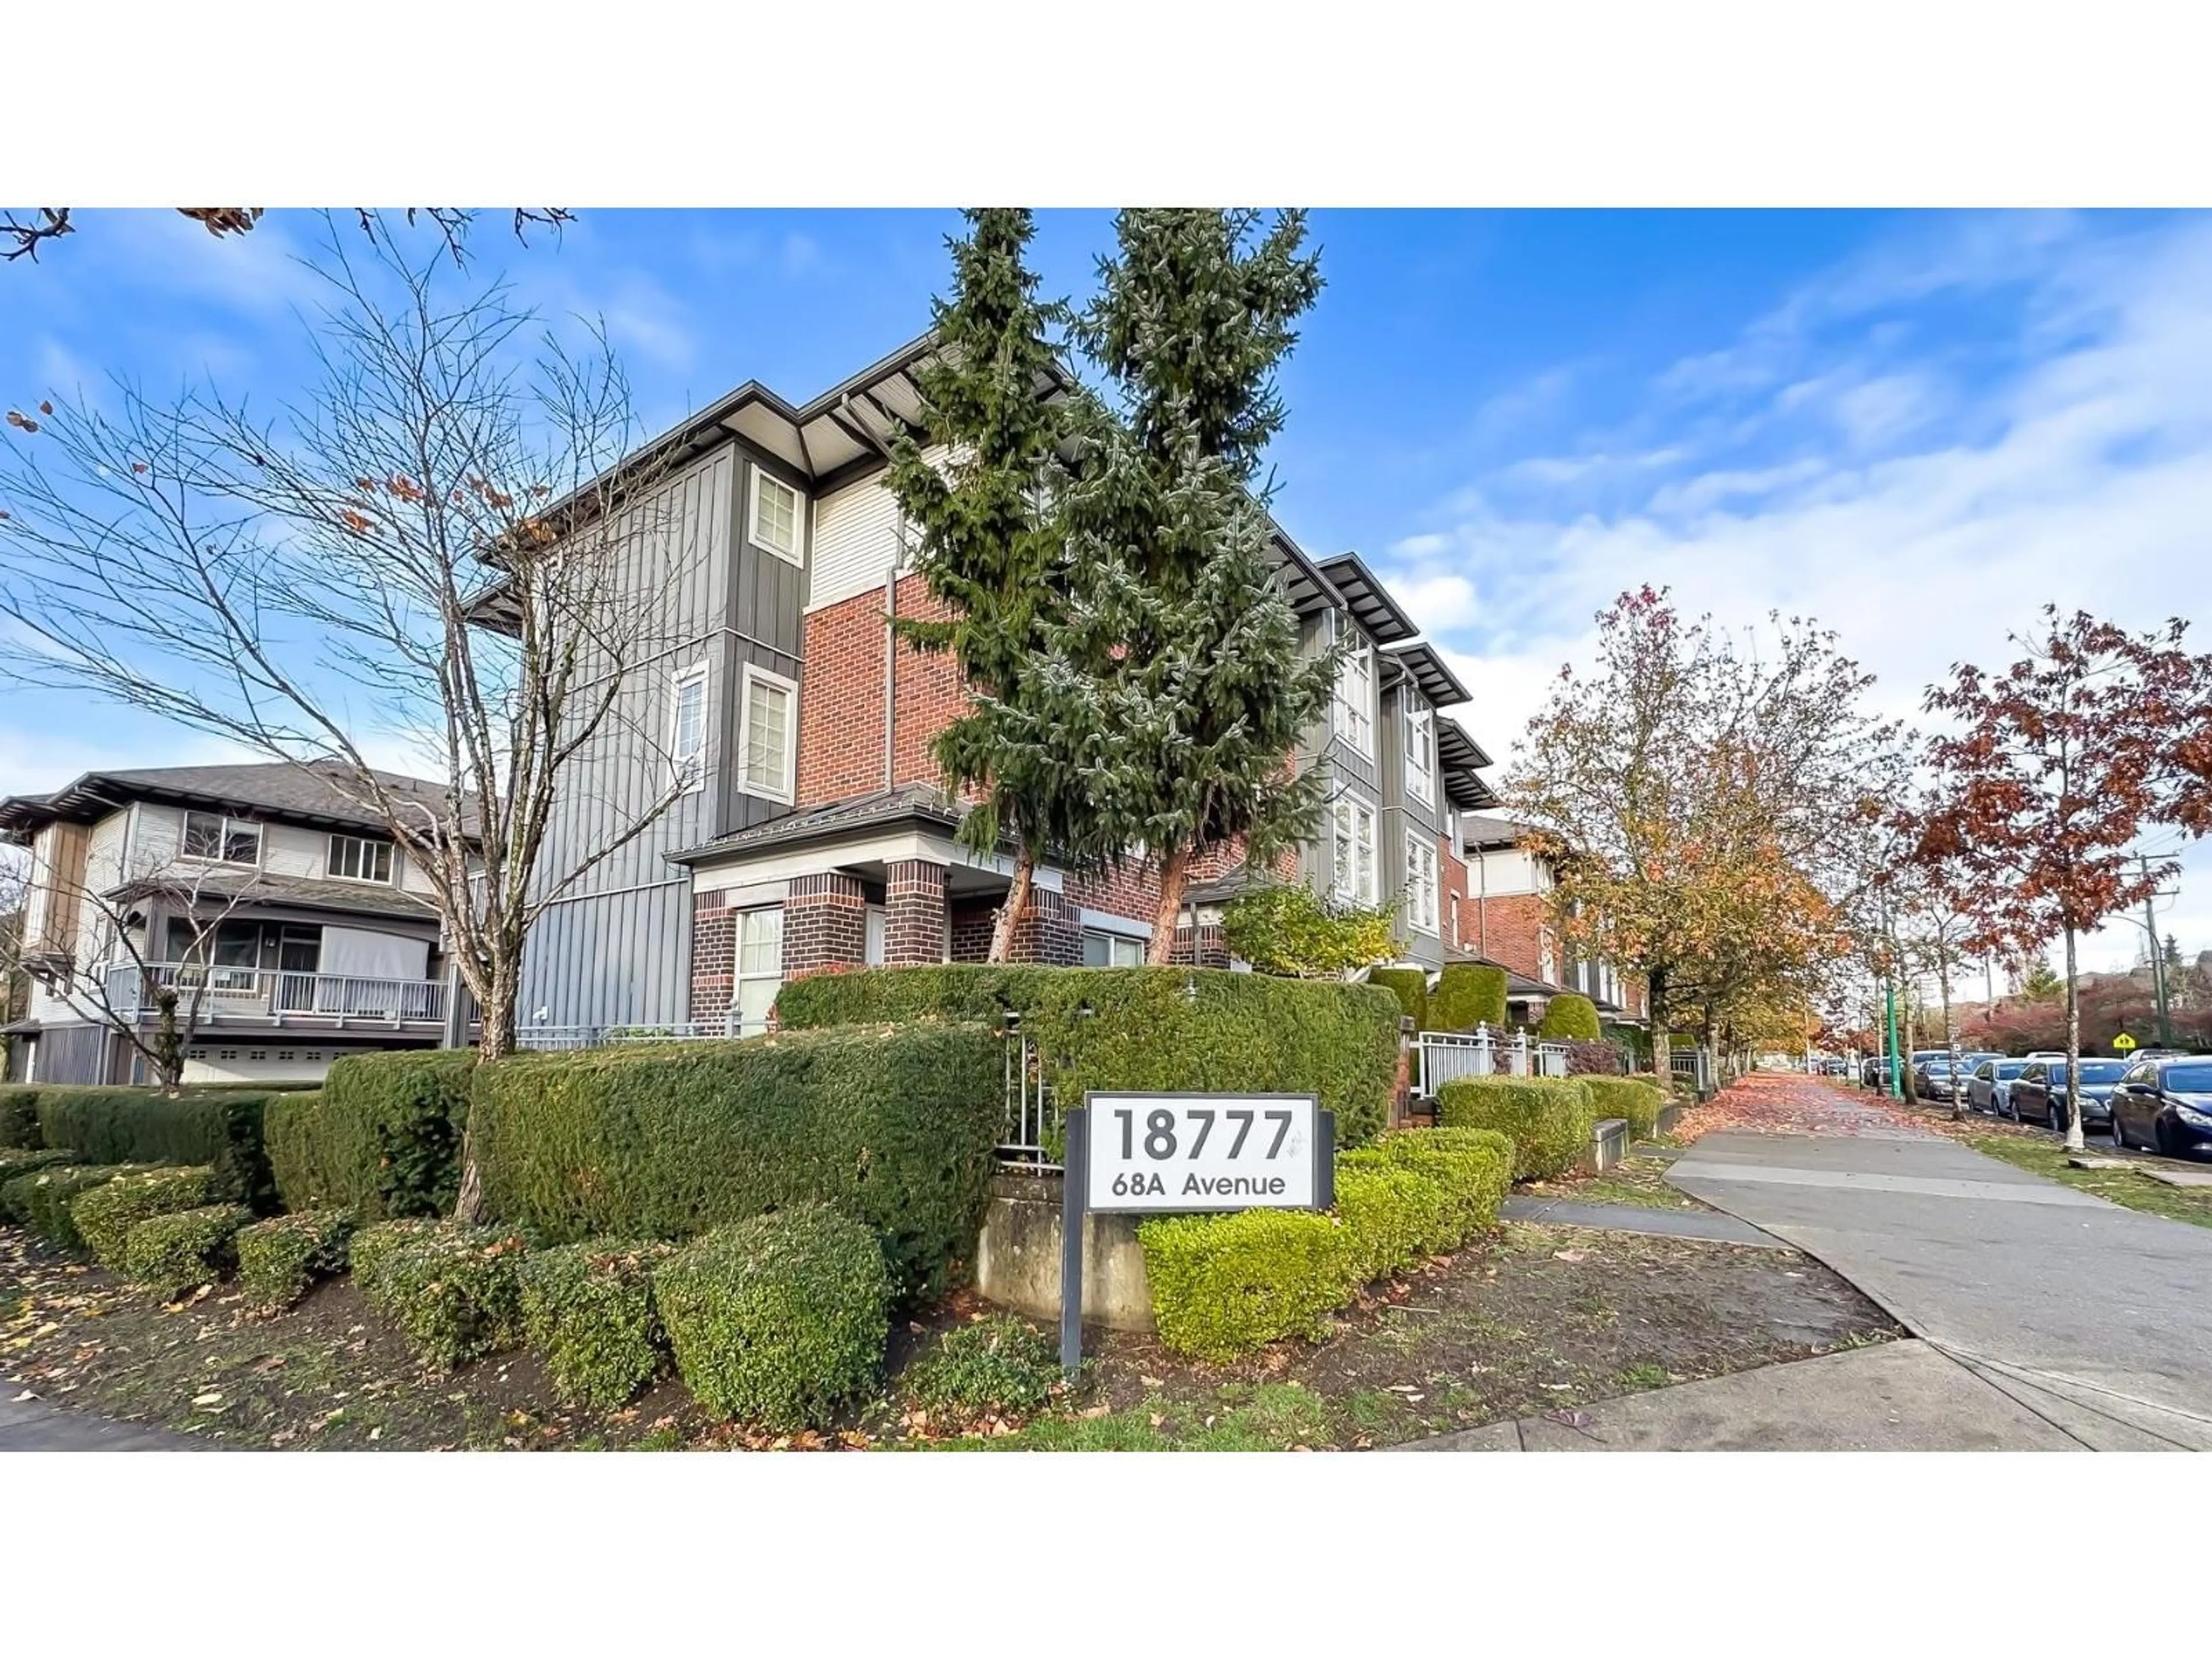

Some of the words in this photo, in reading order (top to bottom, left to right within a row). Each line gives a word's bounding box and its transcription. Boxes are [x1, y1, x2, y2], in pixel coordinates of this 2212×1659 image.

[1114, 1109, 1293, 1160] 18777
[1112, 1172, 1166, 1196] 68A
[1181, 1172, 1286, 1196] Avenue
